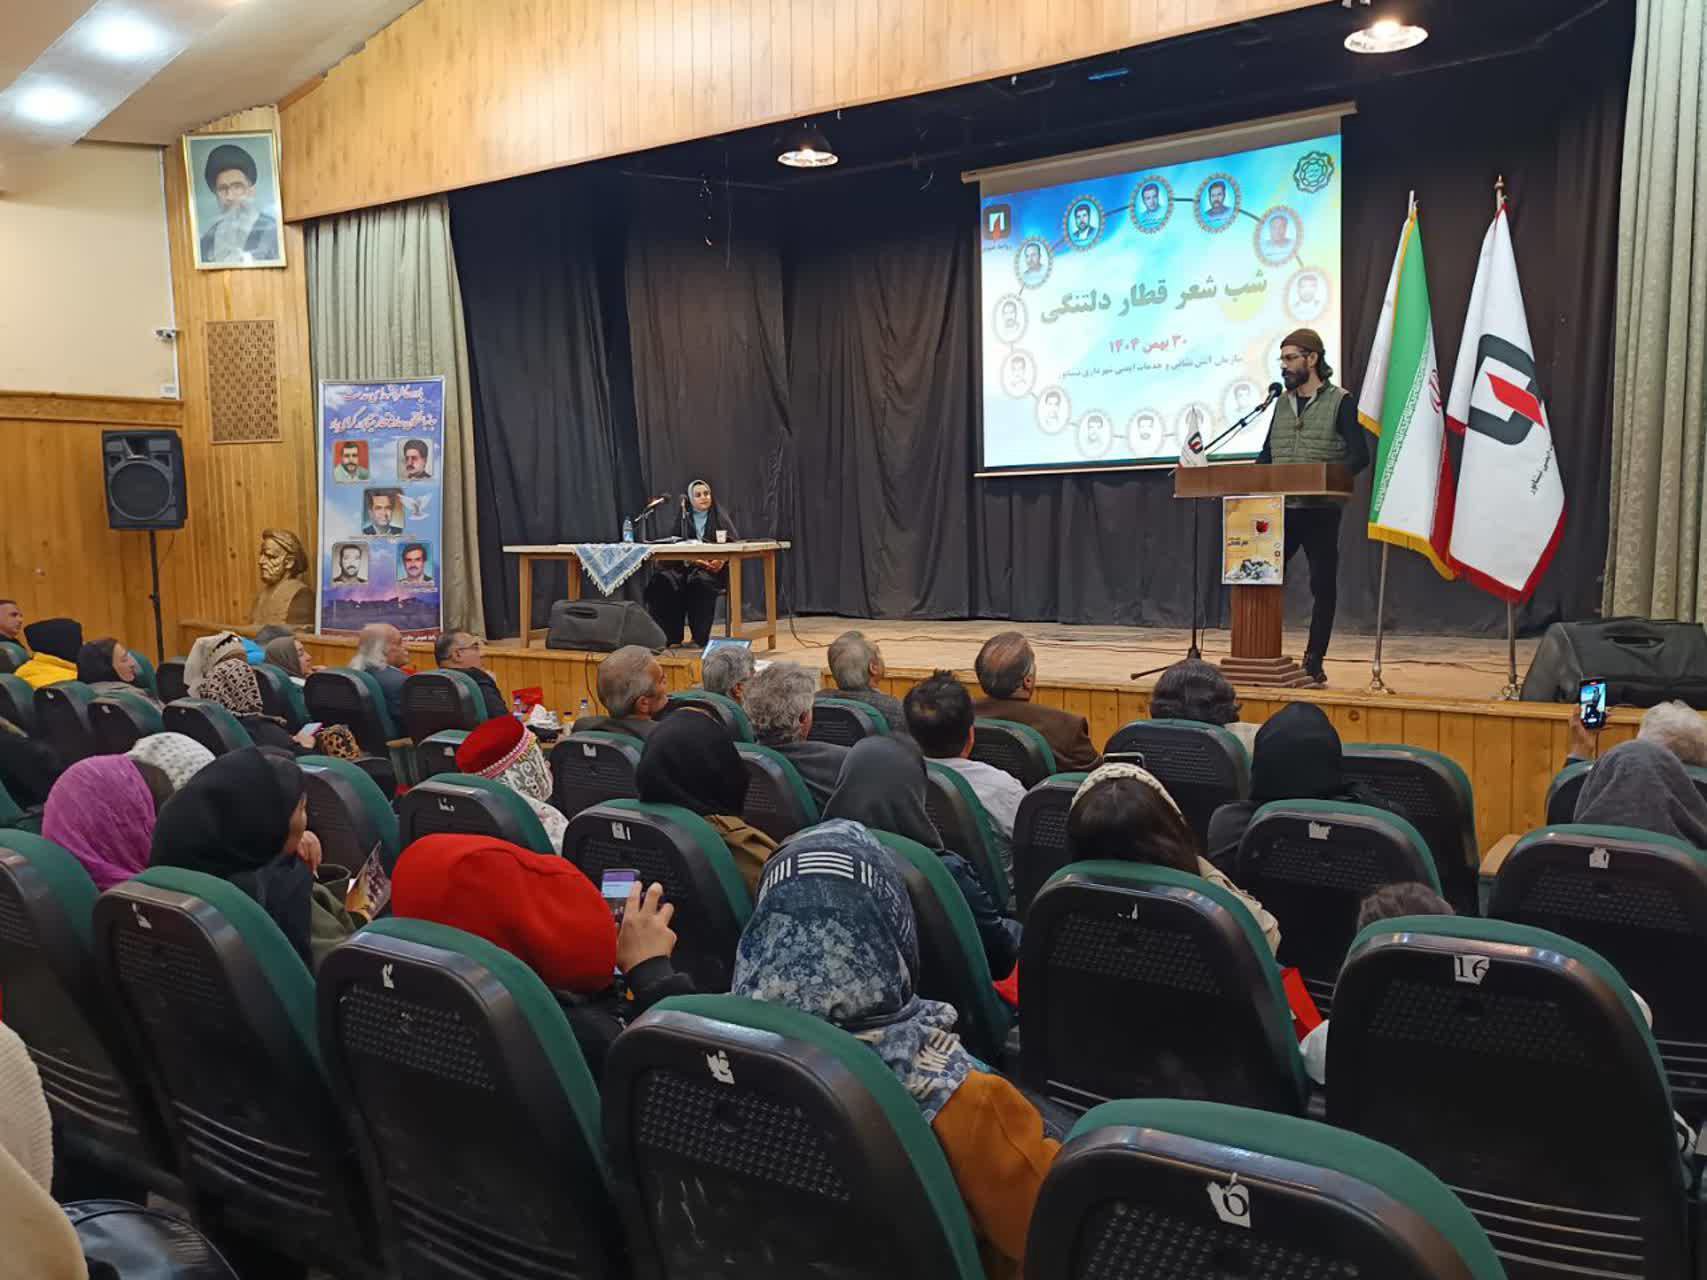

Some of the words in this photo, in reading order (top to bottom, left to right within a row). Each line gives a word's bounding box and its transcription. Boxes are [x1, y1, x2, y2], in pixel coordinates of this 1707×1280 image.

[1117, 279, 1168, 317] قطار
[1175, 275, 1217, 310] شعر
[1224, 269, 1268, 302] شب
[1040, 288, 1112, 325] دلتنگی
